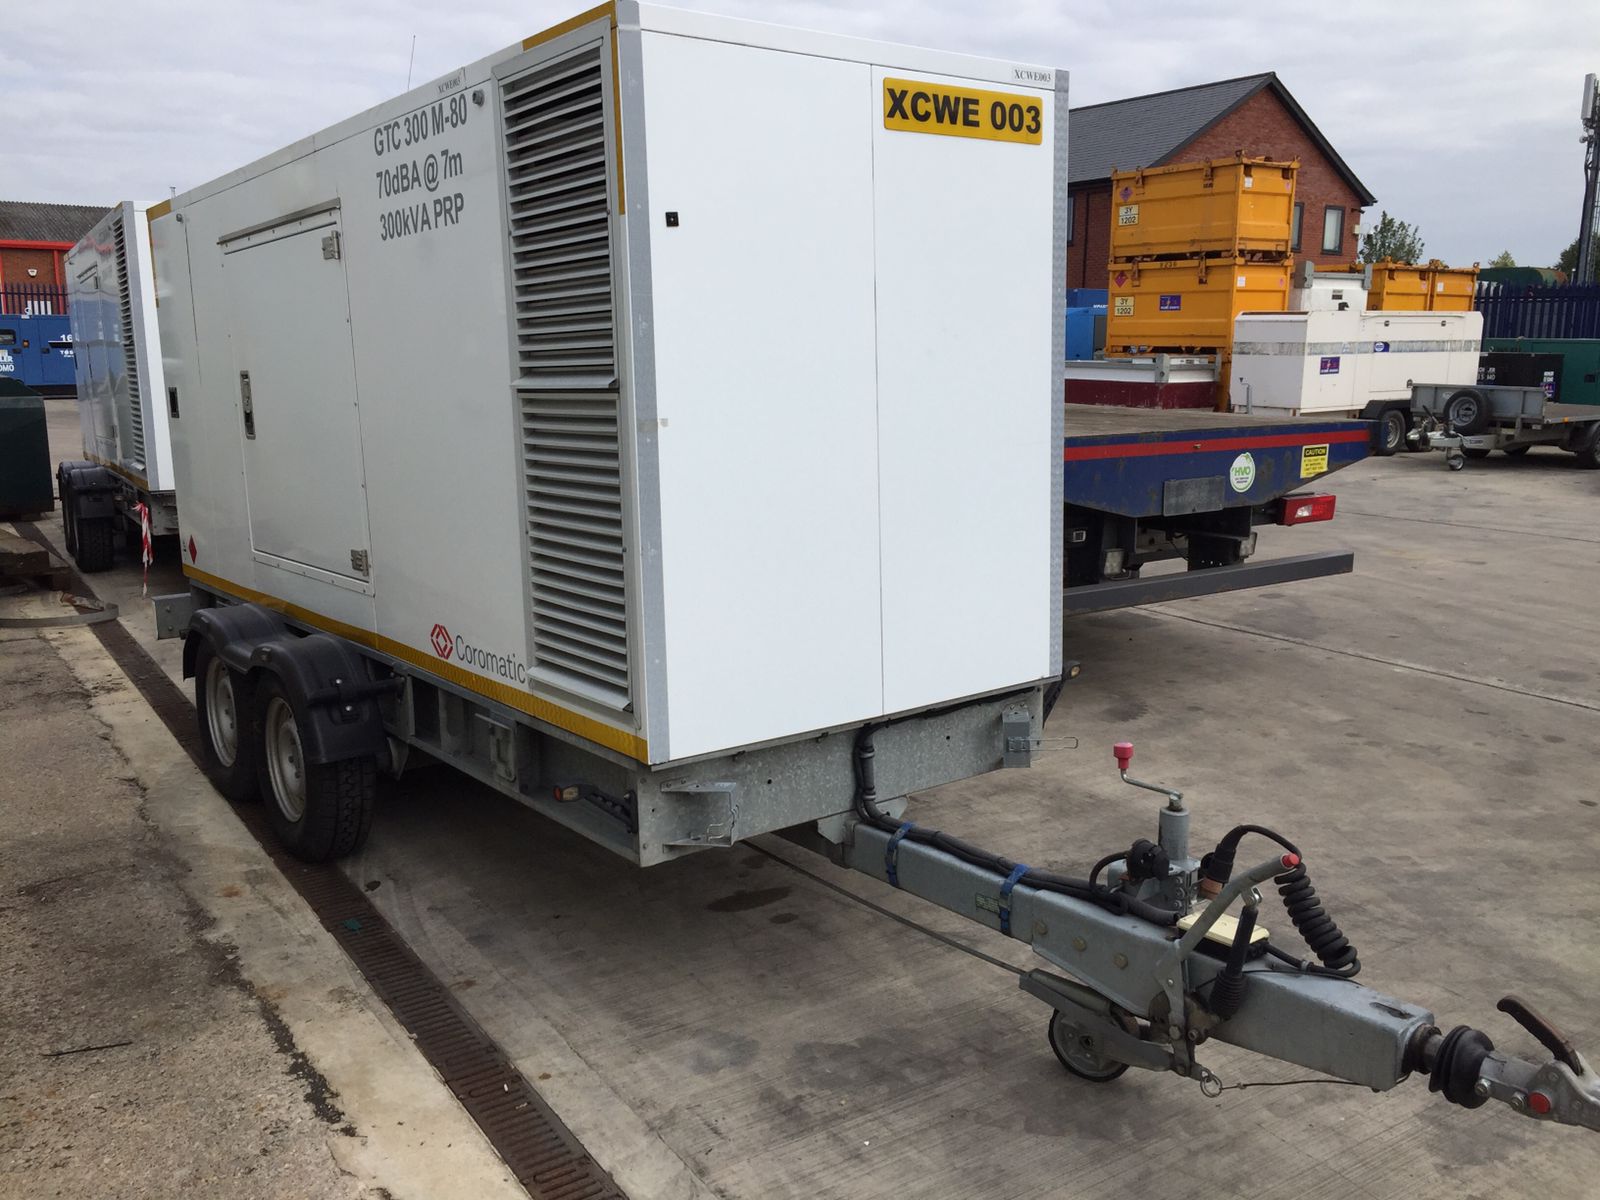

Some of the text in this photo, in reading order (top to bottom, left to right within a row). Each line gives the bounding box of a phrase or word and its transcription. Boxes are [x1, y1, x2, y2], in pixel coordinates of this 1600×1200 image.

[886, 88, 1042, 134] XCWE 003
[374, 93, 468, 156] GTC 300 M-80
[1124, 207, 1133, 215] 3Y
[380, 192, 465, 241] 300kVA PRP
[1120, 216, 1136, 225] 1202
[1120, 298, 1129, 306] 3Y
[1116, 307, 1132, 315] 1202
[1305, 448, 1326, 456] CAUTION
[455, 635, 526, 684] Coromatic
